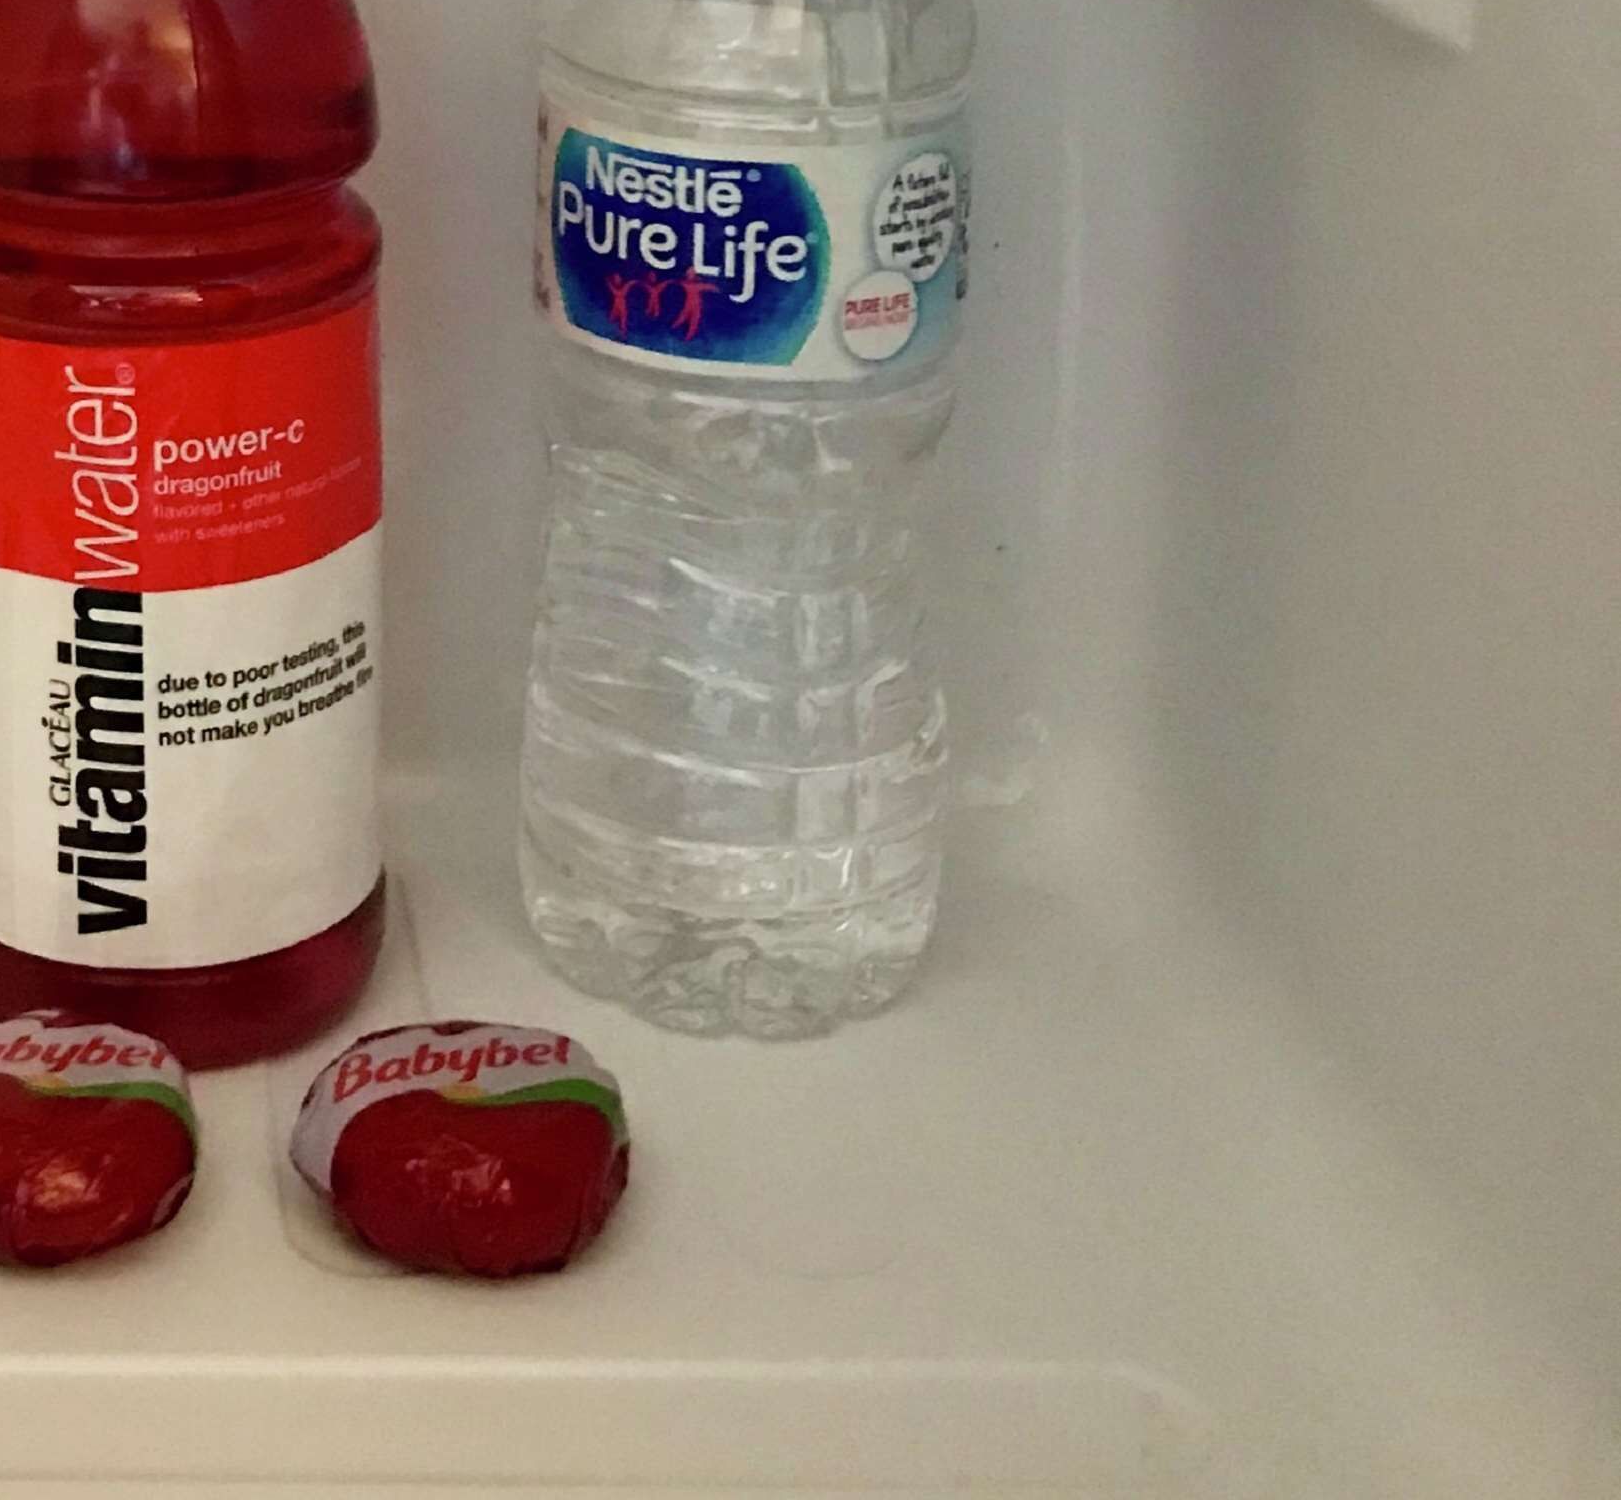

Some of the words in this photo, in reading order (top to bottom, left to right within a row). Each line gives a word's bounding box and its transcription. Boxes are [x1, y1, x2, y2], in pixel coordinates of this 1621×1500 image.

[557, 180, 678, 270] Pure
[692, 219, 810, 304] Life
[845, 296, 881, 315] PURE
[882, 292, 911, 313] LIFE
[153, 418, 305, 473] power-c
[153, 460, 283, 497] dragonfruit
[158, 674, 199, 694] due
[205, 671, 227, 688] to
[232, 660, 279, 688] poor
[282, 637, 340, 672] testing,
[158, 697, 222, 720] bottle
[226, 691, 250, 713] of
[253, 657, 343, 708] dragonfruit
[158, 726, 195, 746] not
[201, 719, 259, 743] make
[263, 708, 295, 735] you
[298, 679, 355, 718] breathe
[334, 1035, 571, 1104] Babybel
